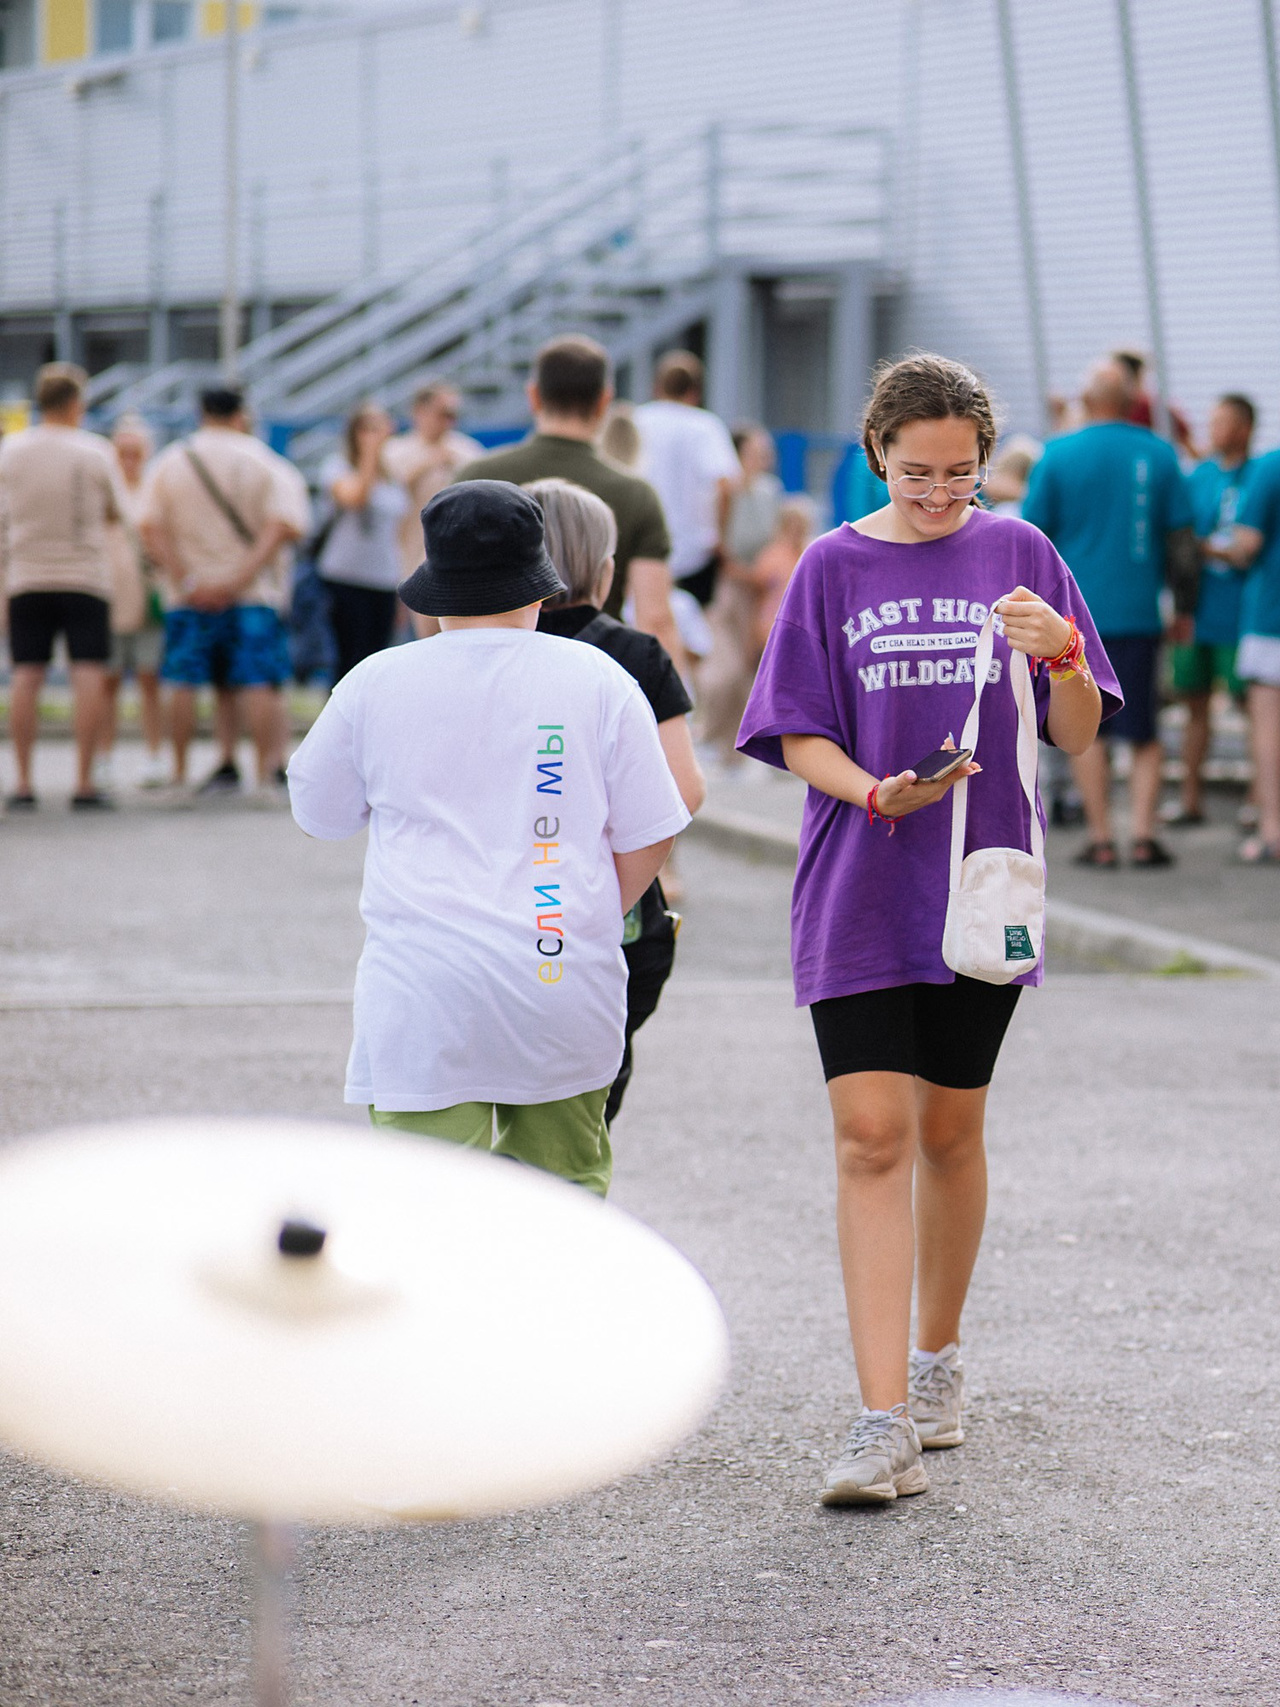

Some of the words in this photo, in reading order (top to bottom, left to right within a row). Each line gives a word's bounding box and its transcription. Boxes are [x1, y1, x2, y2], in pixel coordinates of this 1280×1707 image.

[841, 597, 922, 648] EAST
[872, 640, 887, 650] GET
[889, 639, 904, 647] CHA
[906, 638, 926, 647] HEAD
[927, 638, 936, 646] IN
[938, 637, 953, 646] THE
[955, 635, 977, 645] GAME
[857, 657, 1003, 692] WILDCAS
[536, 724, 564, 796] мы
[533, 816, 560, 866] не
[534, 884, 564, 984] если
